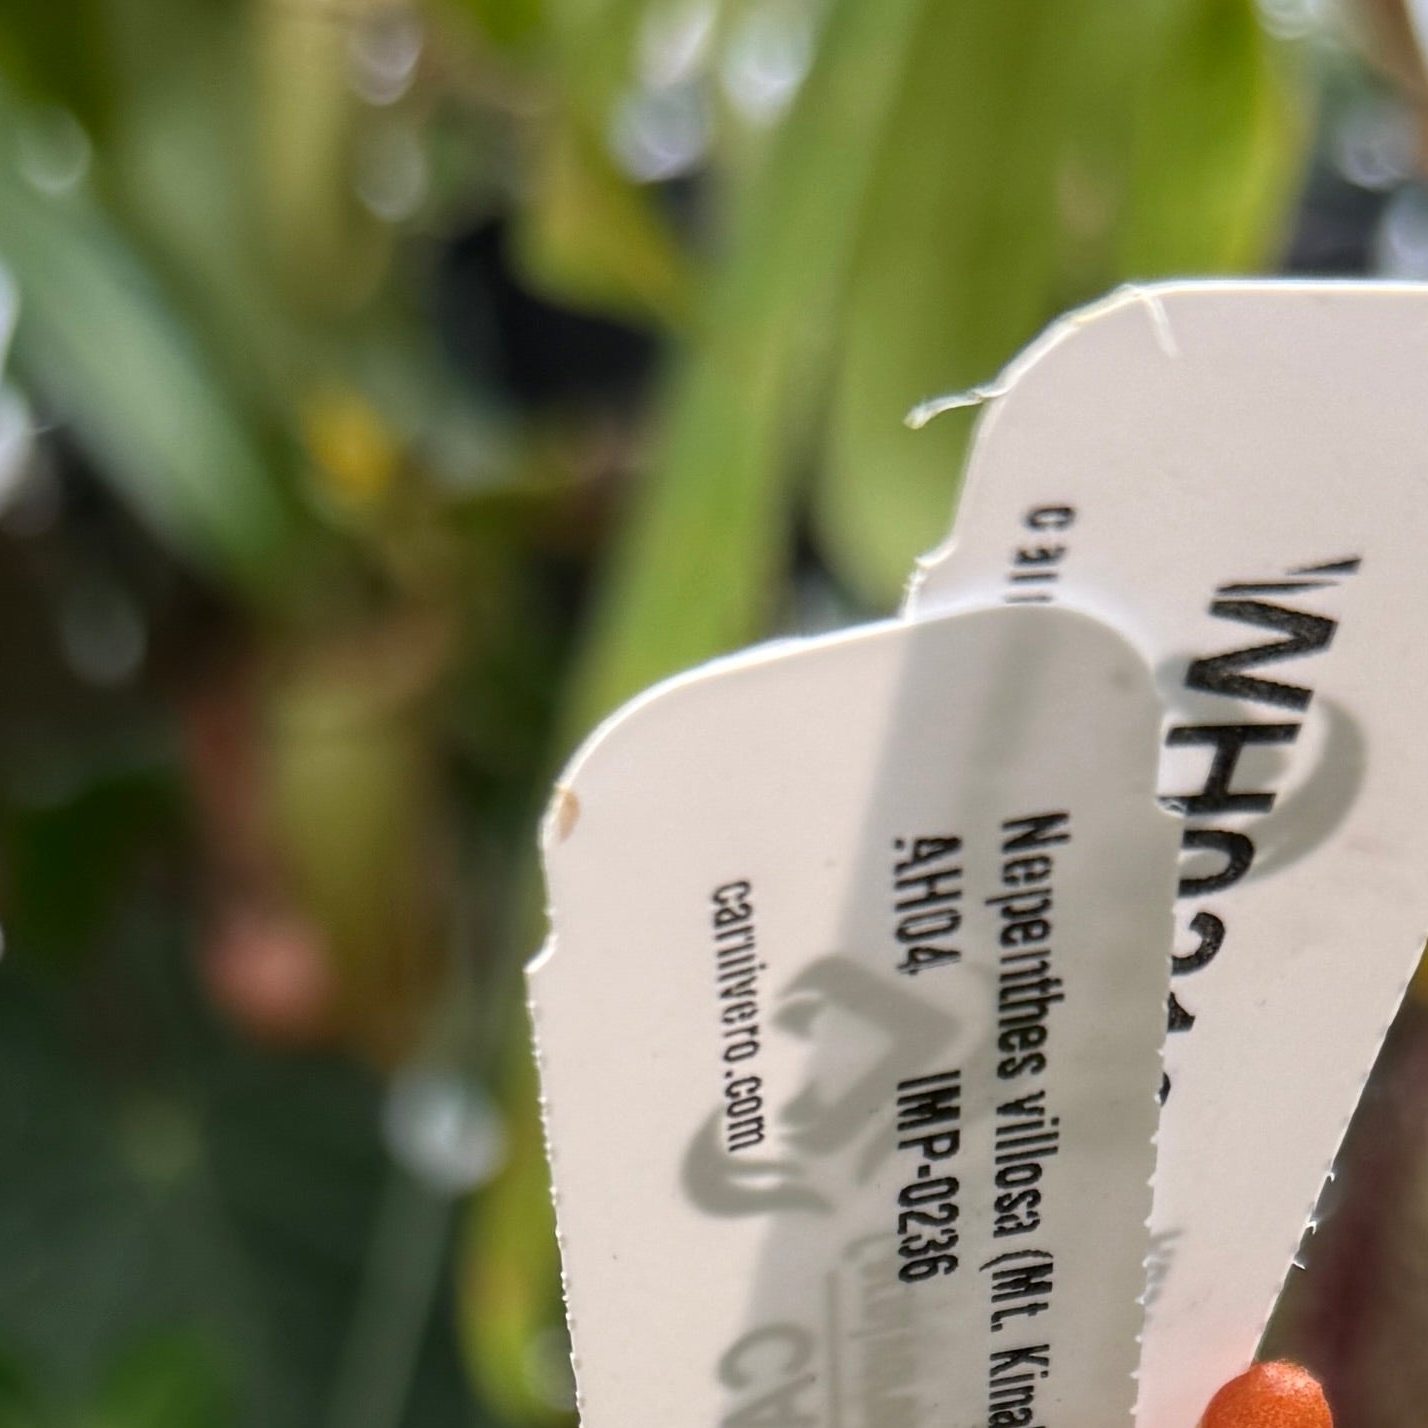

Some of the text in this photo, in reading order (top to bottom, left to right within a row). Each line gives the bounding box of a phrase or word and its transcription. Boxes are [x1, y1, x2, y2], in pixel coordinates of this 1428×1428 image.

[712, 880, 769, 1154] carnivero.com
[892, 836, 964, 1284] AH04 IMP-0236
[984, 811, 1072, 1083] Nepenthes
[978, 1250, 1056, 1335] (Mt.
[992, 1091, 1060, 1240] villosa
